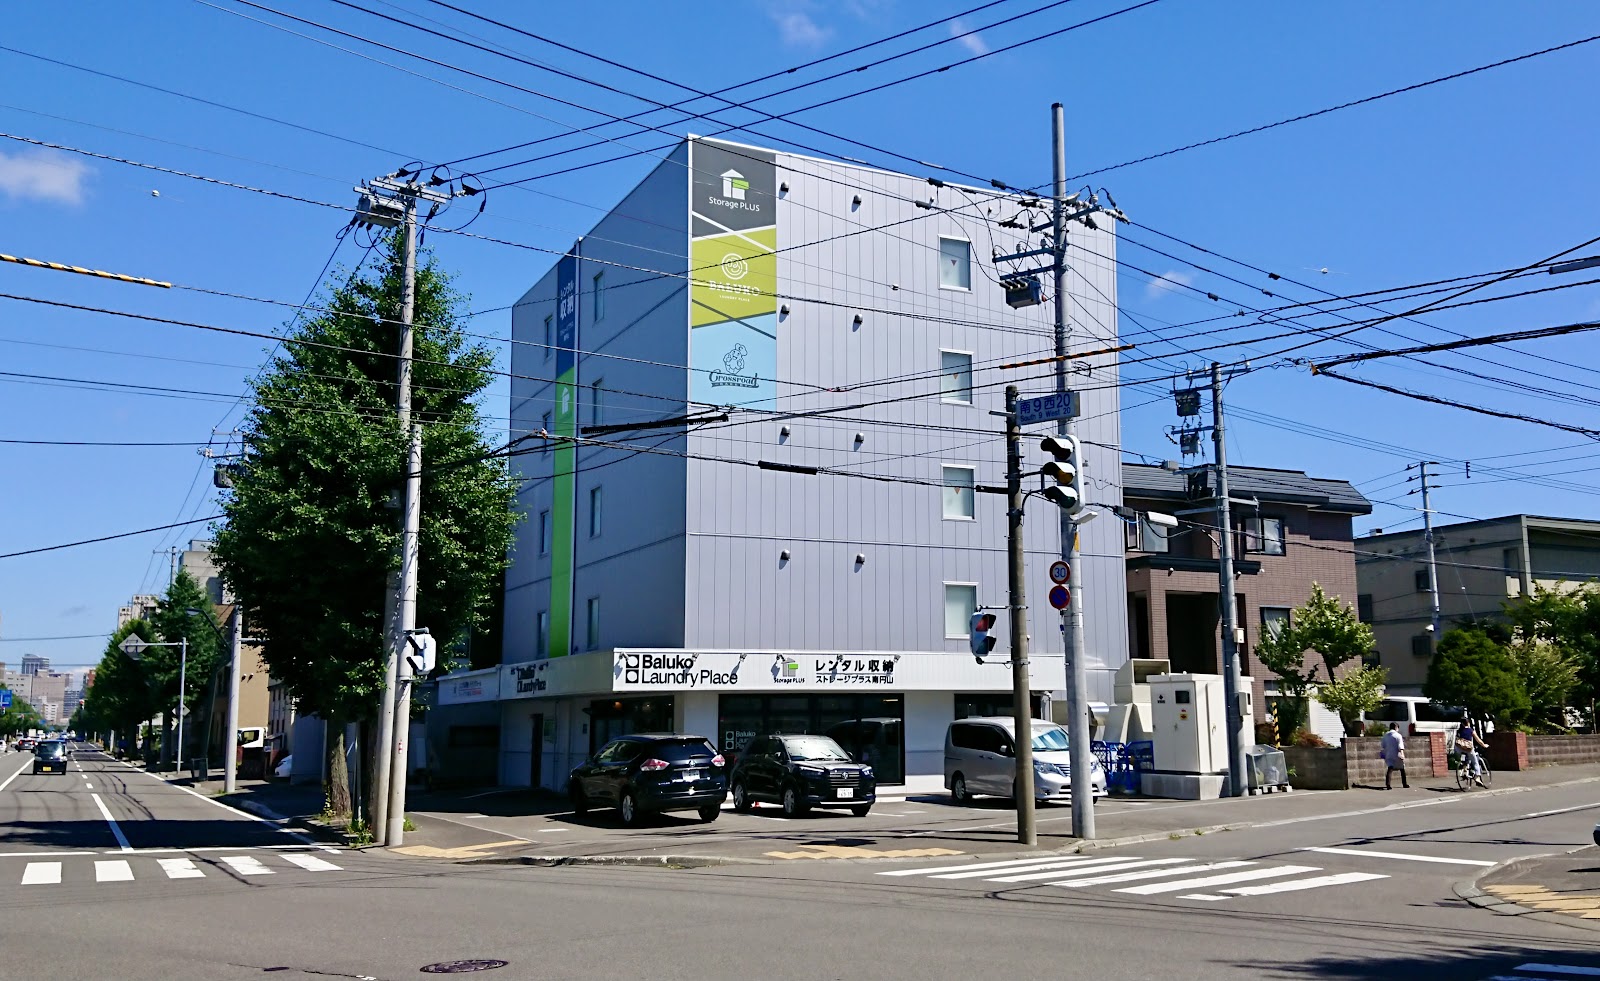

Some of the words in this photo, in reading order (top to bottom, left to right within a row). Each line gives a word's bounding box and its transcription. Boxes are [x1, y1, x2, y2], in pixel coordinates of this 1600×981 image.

[708, 196, 739, 209] Storage
[740, 202, 760, 212] PLUS
[1020, 414, 1037, 422] South
[1038, 411, 1043, 419] 9
[1045, 409, 1061, 418] West
[1063, 406, 1071, 415] 20
[1054, 567, 1067, 578] 30
[642, 654, 694, 669] Baluko
[641, 669, 699, 687] Laundry
[700, 669, 738, 685] Place
[773, 676, 792, 685] Storage
[815, 675, 894, 684] ストレージプラス南円山
[735, 730, 756, 738] Baluko
